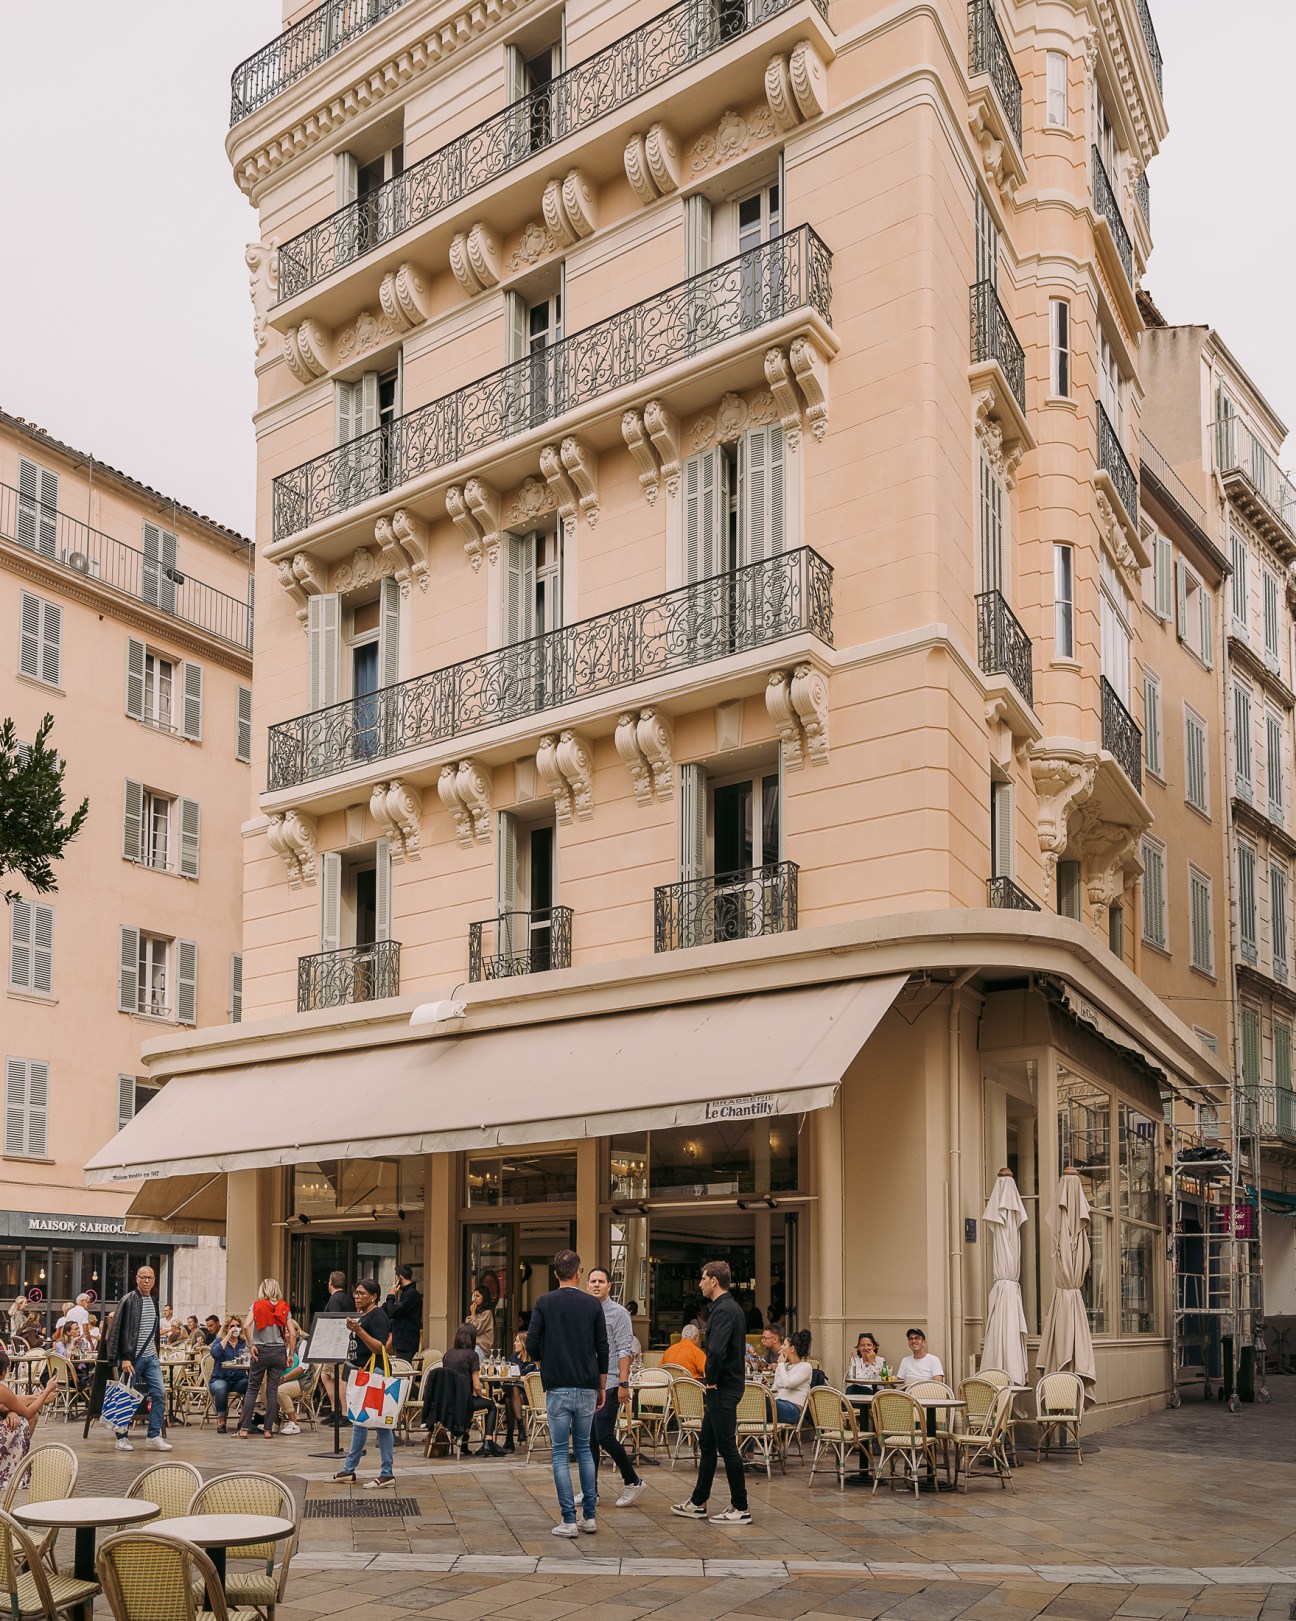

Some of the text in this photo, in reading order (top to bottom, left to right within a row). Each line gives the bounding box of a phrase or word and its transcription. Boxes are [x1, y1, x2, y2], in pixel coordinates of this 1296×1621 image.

[712, 1095, 775, 1107] BRASSERIE
[705, 1102, 774, 1119] Le Chantilly
[28, 1219, 139, 1235] MAISON SARROC
